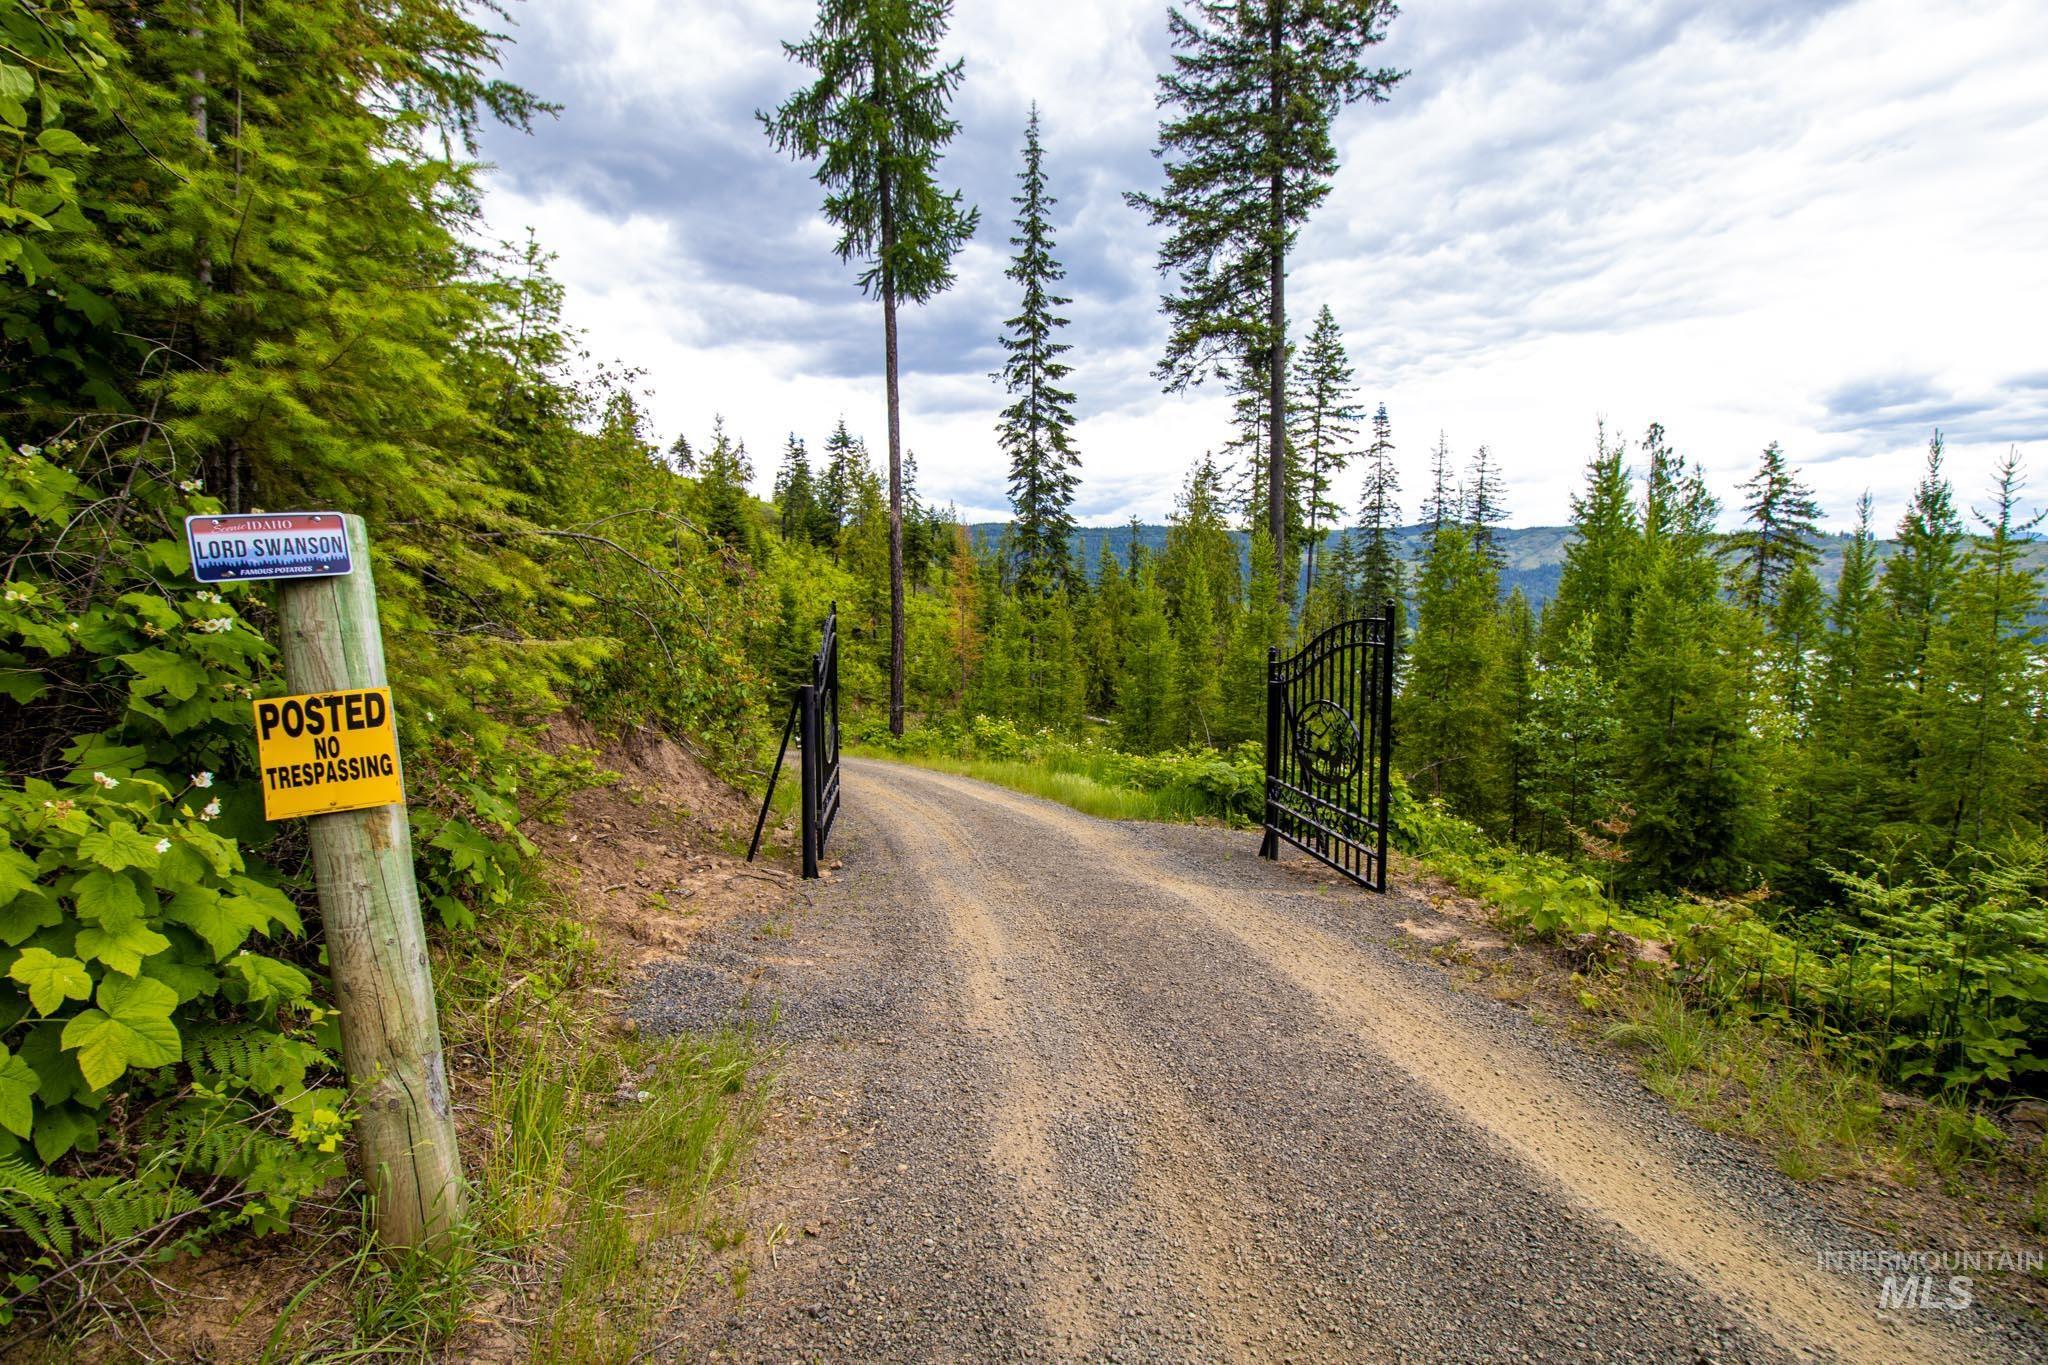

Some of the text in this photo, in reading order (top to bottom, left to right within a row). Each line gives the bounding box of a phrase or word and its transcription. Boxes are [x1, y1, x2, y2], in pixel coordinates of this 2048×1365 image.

[211, 520, 293, 534] Scenic IDAHO
[196, 535, 343, 560] LORD SWANSON
[240, 565, 313, 576] FAMOUS POTATOES
[259, 692, 386, 741] POSTED
[314, 736, 340, 760] NO
[266, 754, 393, 790] TRESPASSING
